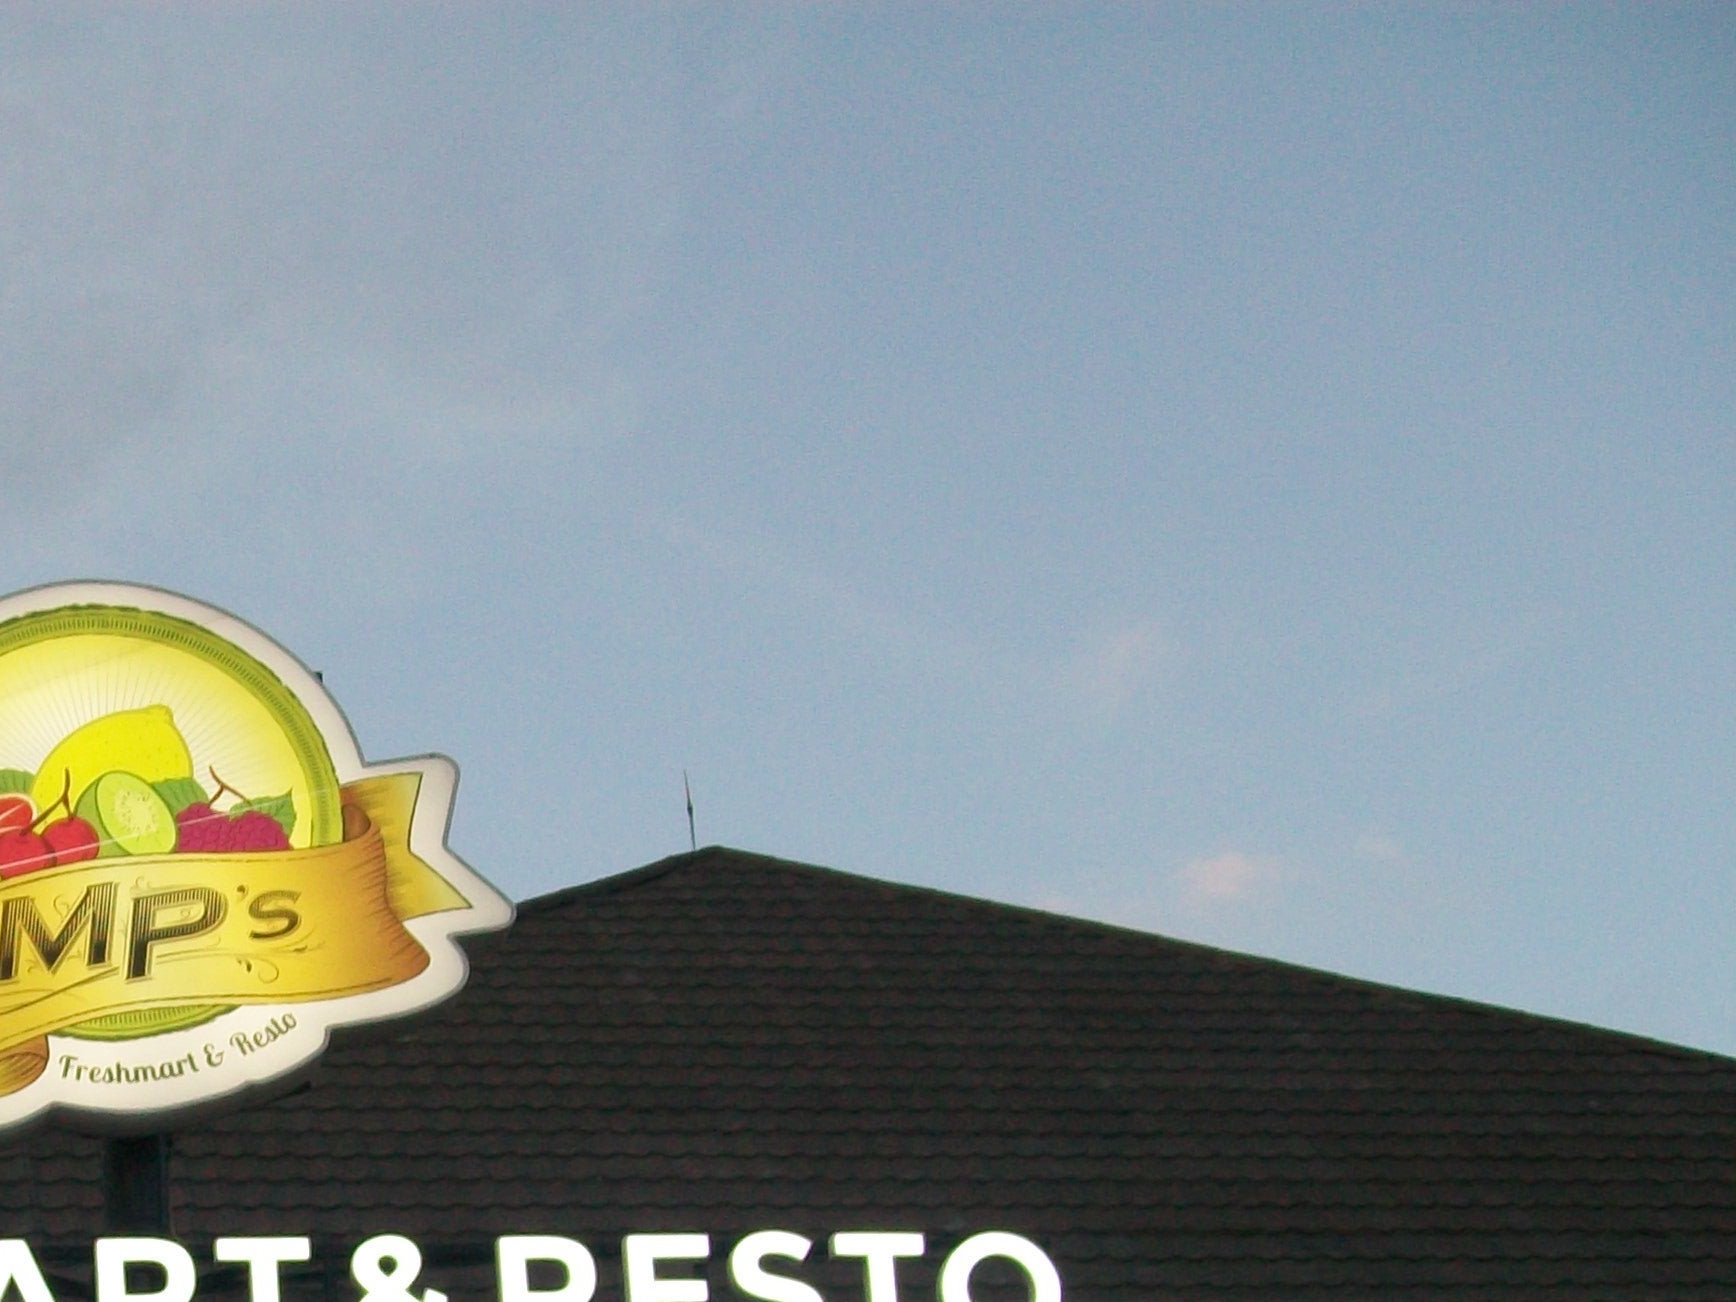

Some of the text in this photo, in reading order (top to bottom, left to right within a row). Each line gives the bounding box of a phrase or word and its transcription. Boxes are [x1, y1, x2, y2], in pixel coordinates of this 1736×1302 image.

[59, 1011, 298, 1084] Freshmart & Resto
